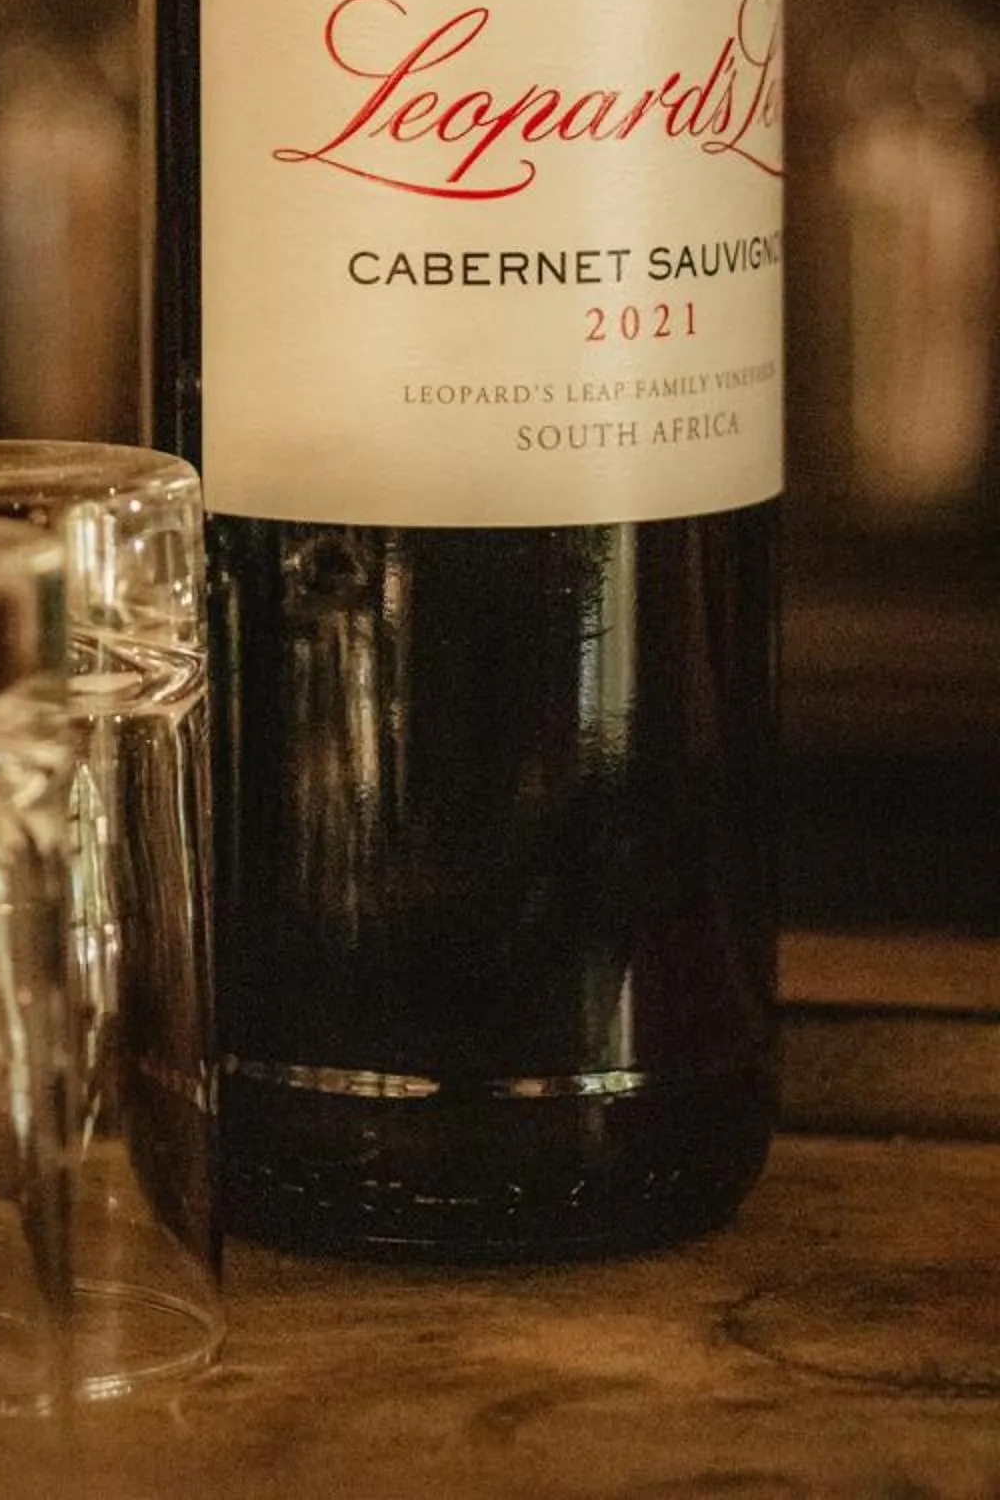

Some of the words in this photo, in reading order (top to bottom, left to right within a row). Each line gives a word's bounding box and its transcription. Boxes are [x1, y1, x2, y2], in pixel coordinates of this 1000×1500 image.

[348, 250, 632, 286] CABERNET
[585, 302, 697, 342] 2021
[403, 383, 554, 404] LEOPARD'S
[566, 381, 625, 403] LEAP
[635, 370, 710, 399] FAMILY
[516, 421, 637, 451] SOUTH
[652, 411, 740, 445] AFRICA
